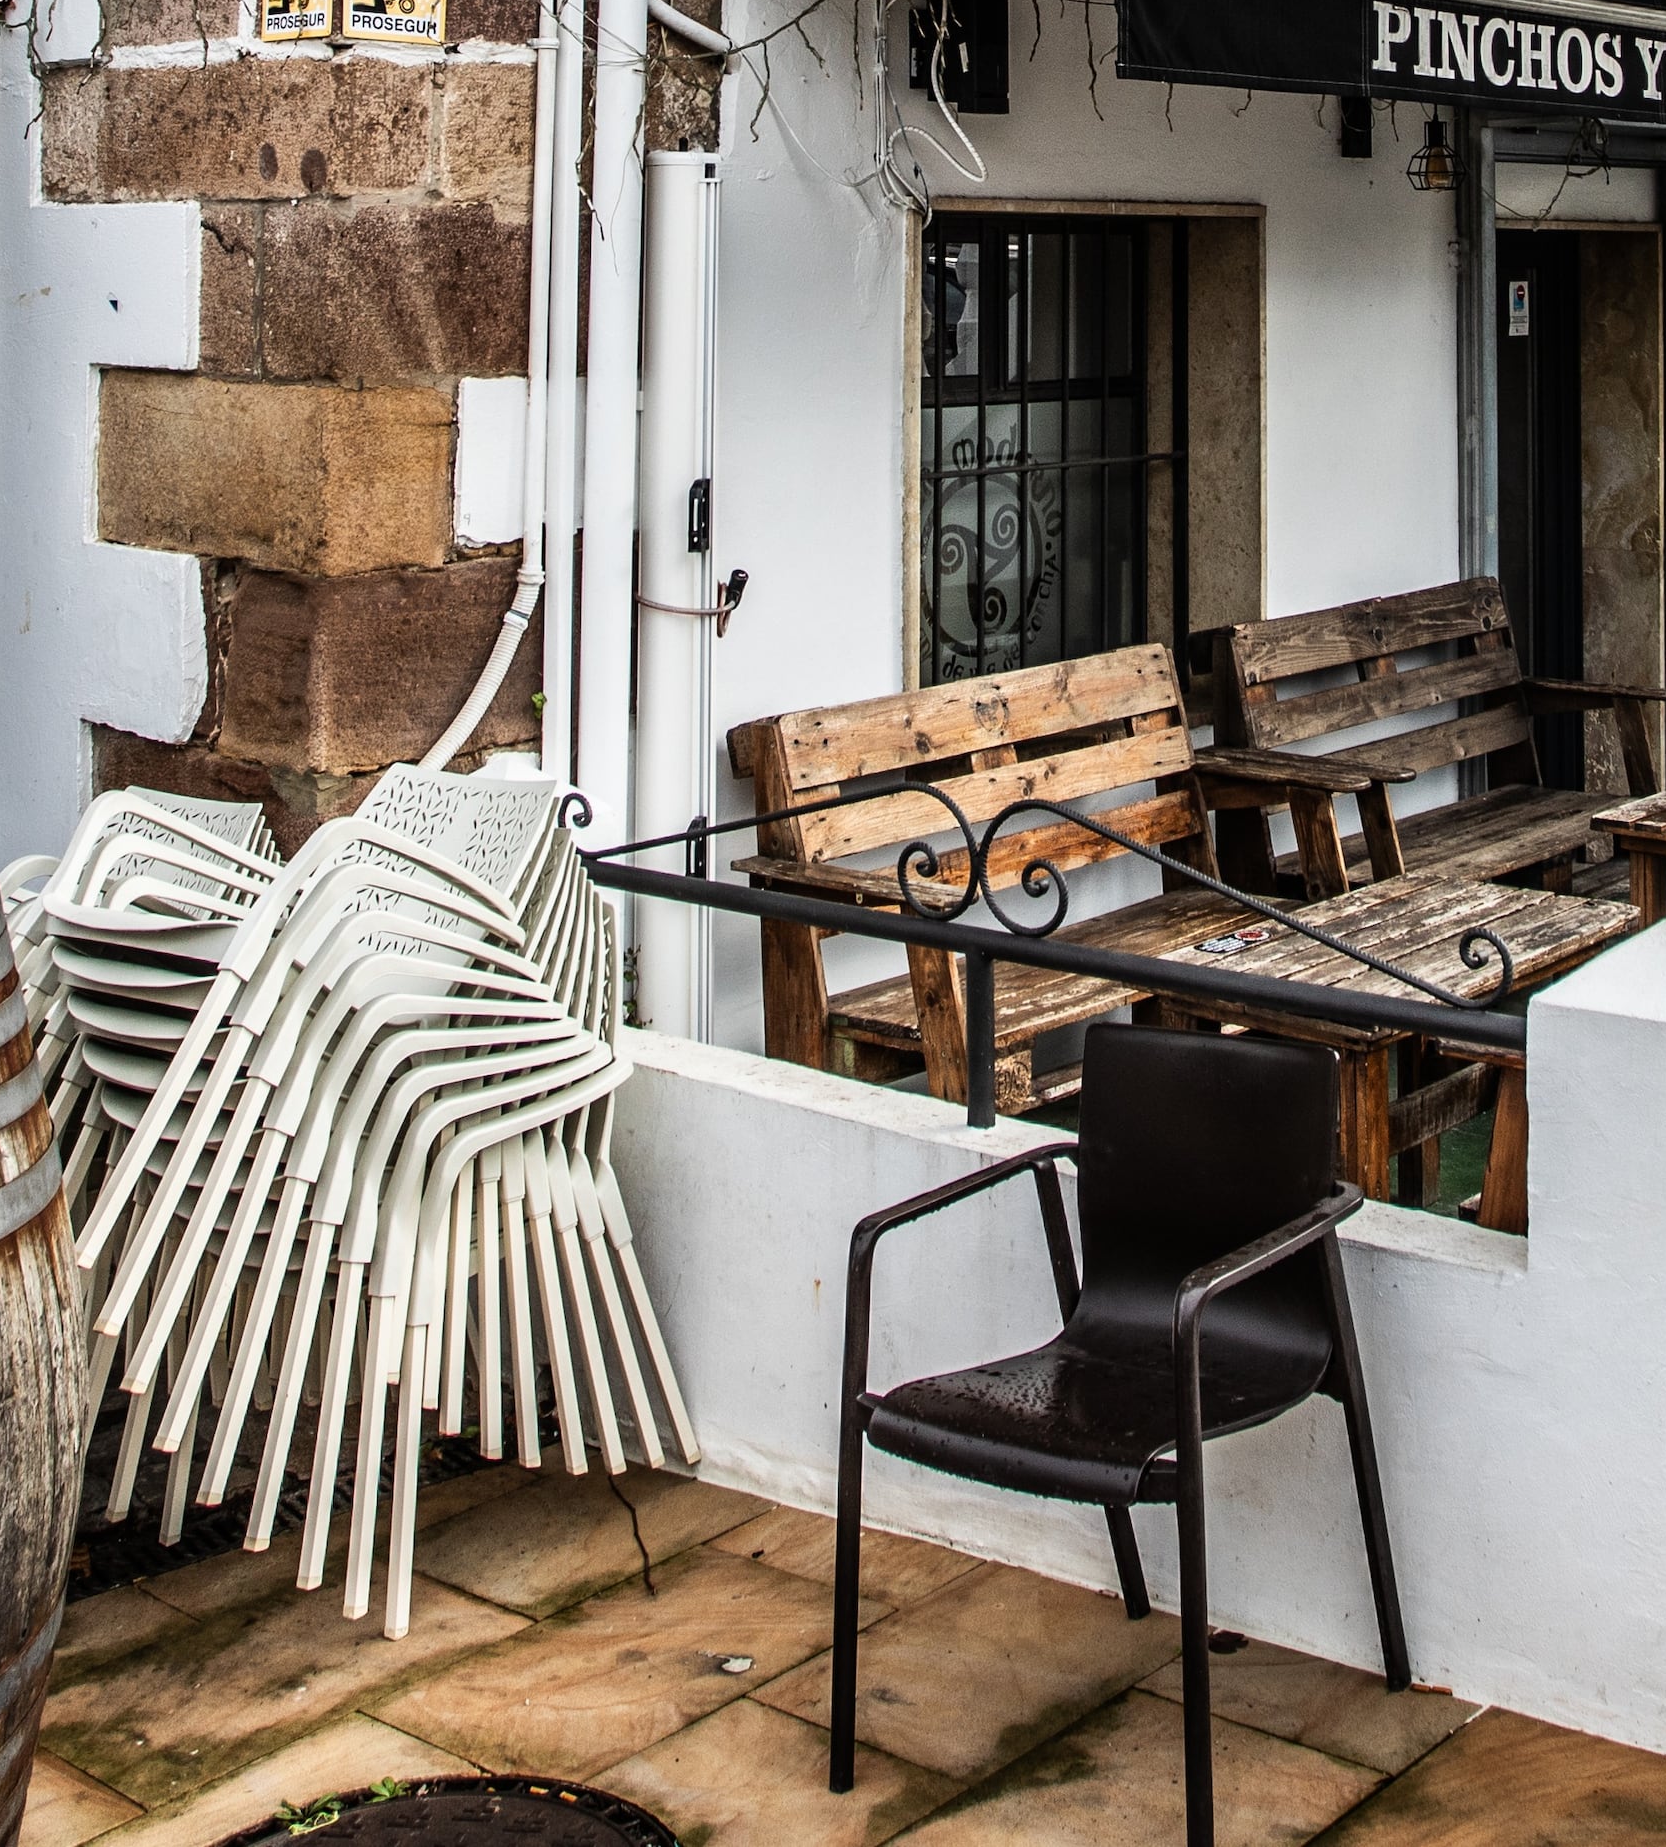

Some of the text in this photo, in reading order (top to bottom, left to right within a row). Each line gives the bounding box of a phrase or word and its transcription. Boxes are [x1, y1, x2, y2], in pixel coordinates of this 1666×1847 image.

[267, 13, 325, 31] PROSEGUR
[353, 15, 437, 34] PROSEGUR
[1372, 1, 1623, 98] PINCHOS
[1635, 38, 1666, 101] Y
